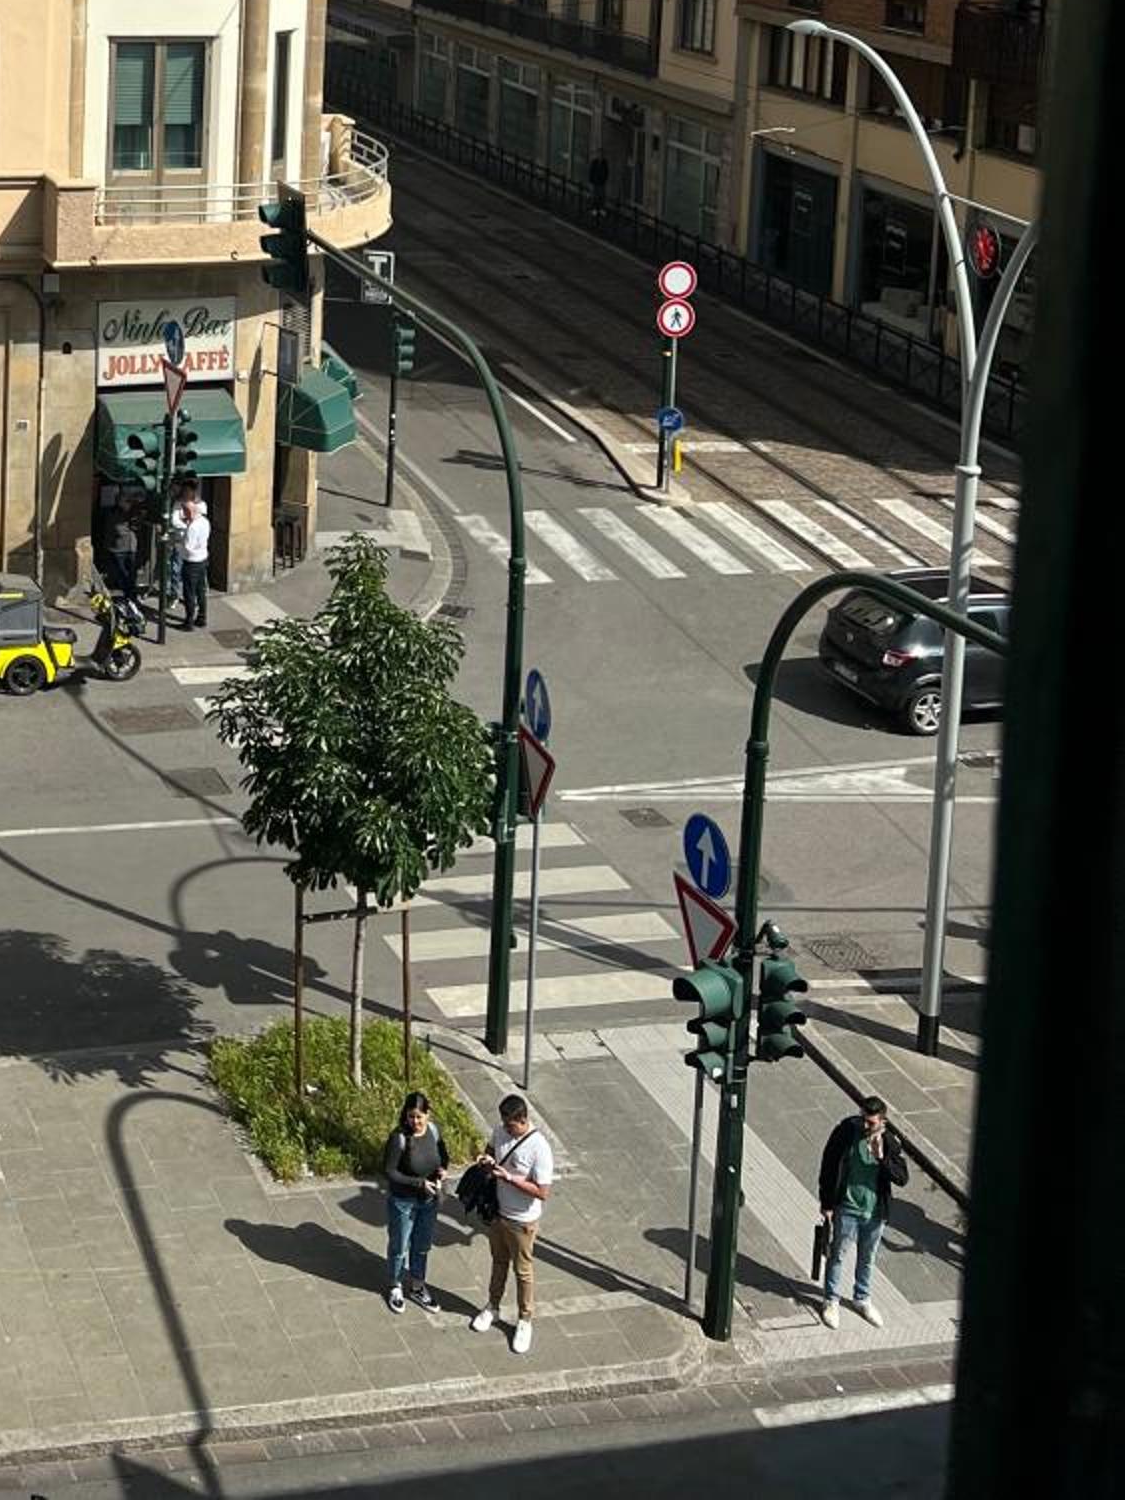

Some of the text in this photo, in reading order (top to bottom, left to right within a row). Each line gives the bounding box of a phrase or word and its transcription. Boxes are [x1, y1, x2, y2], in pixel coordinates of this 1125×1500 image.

[368, 255, 388, 277] T
[102, 306, 230, 345] Ninf Bar
[102, 345, 230, 380] JOLLY AFFÈ
